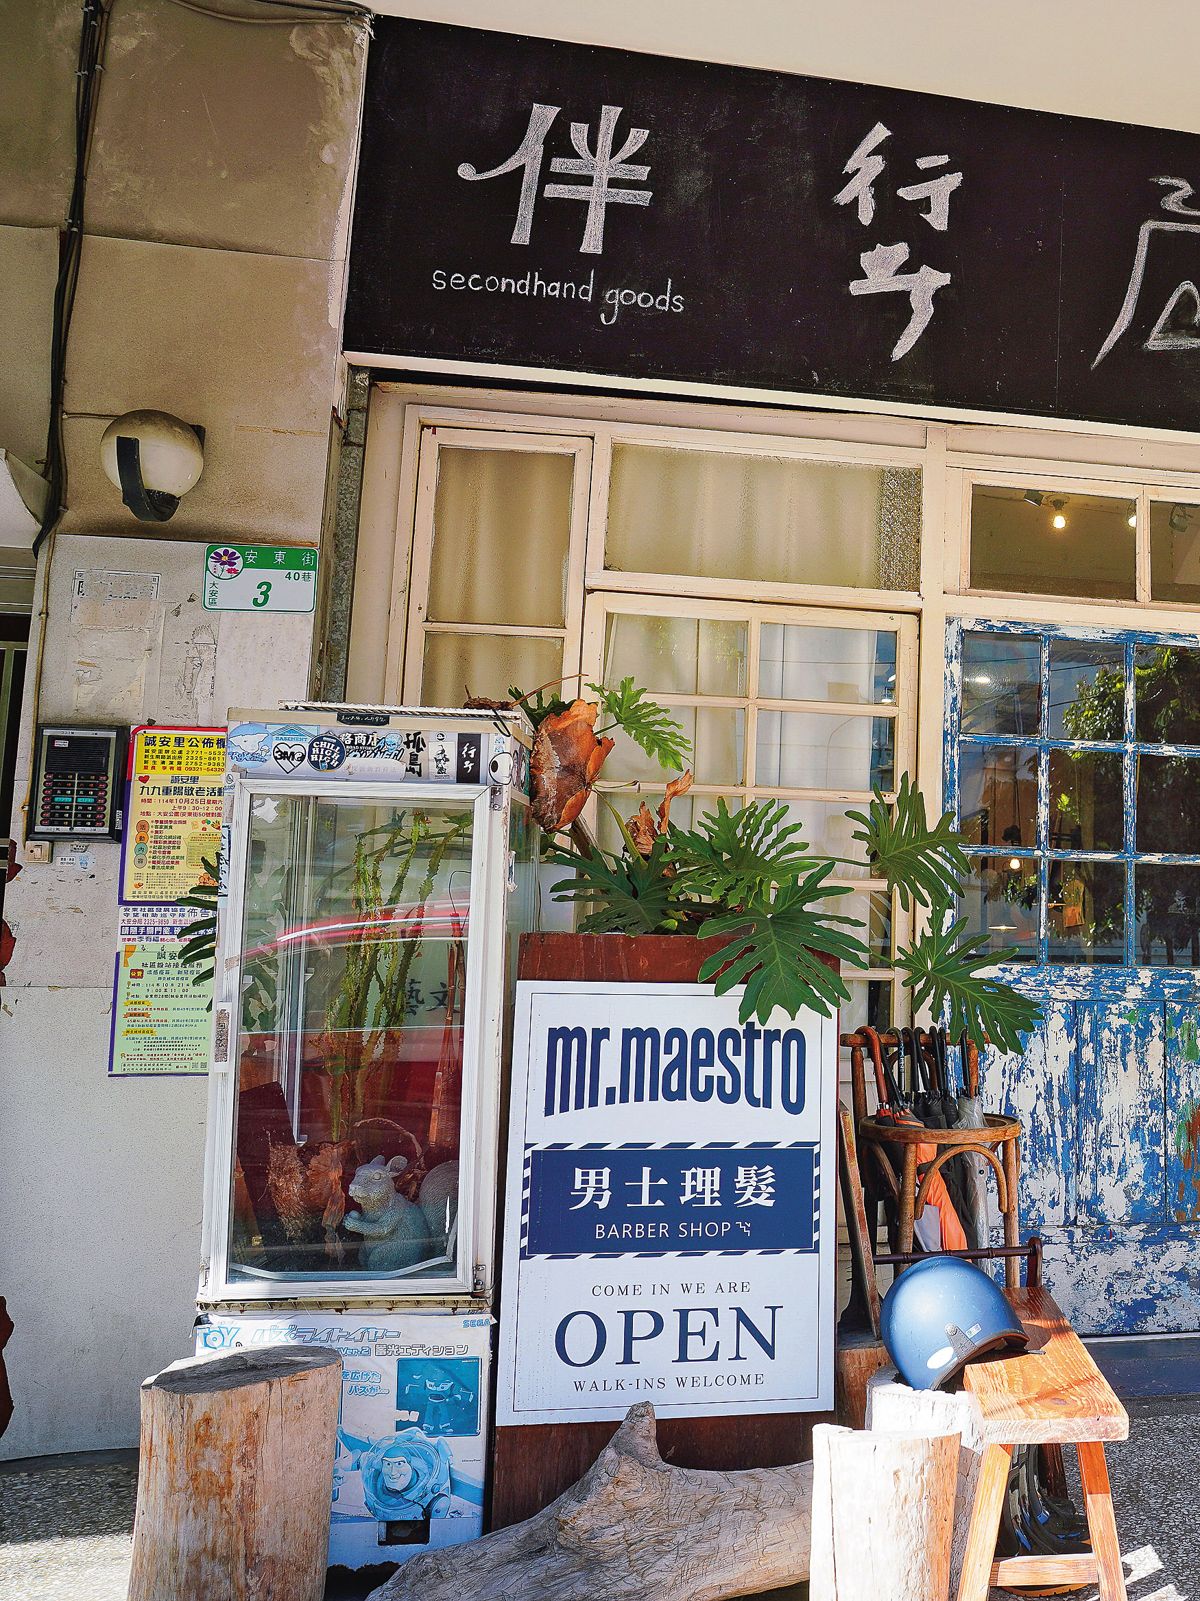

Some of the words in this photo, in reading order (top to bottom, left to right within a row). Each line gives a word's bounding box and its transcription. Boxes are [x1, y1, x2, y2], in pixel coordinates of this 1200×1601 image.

[457, 102, 653, 255] 伴
[432, 269, 594, 303] secondhand
[603, 279, 685, 325] goods
[244, 549, 315, 566] 安東街
[285, 572, 312, 582] 40巷
[208, 581, 219, 606] 大安區
[252, 581, 272, 607] 3
[312, 748, 340, 760] HIGH
[313, 742, 340, 753] CHILL
[187, 907, 217, 918] 佈告
[544, 1022, 806, 1117] mr.maestro
[569, 1165, 777, 1210] 男士理髮
[595, 1223, 669, 1239] BARBER
[679, 1221, 731, 1237] SHOP
[591, 1283, 642, 1297] COME
[651, 1283, 671, 1296] IN
[680, 1282, 706, 1294] WE
[714, 1281, 751, 1294] ARE
[463, 1319, 490, 1328] SEGA
[554, 1305, 783, 1368] OPEN
[573, 1377, 667, 1392] WALK-INS
[675, 1373, 765, 1388] WELCOME
